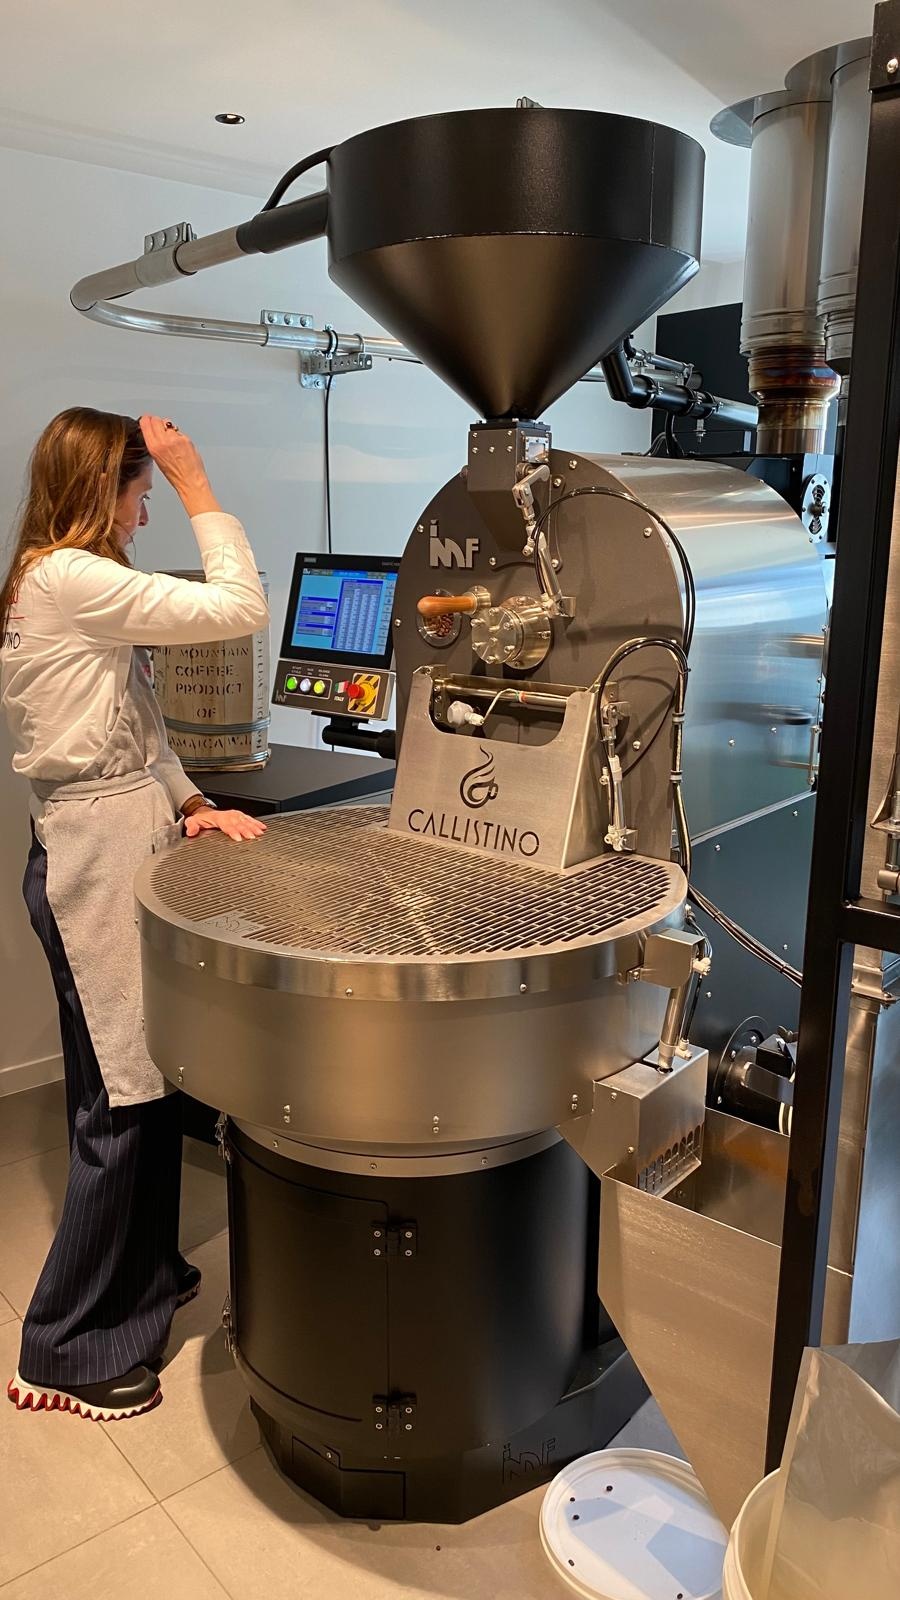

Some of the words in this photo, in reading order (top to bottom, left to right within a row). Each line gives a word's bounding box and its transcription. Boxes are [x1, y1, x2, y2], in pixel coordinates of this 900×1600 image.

[180, 646, 249, 658] MOUNTAIN
[175, 665, 235, 677] COFFEE
[176, 683, 242, 696] PRODUCT
[196, 707, 216, 719] OF
[167, 735, 224, 750] AMAICA
[408, 809, 540, 857] CALLISTINO
